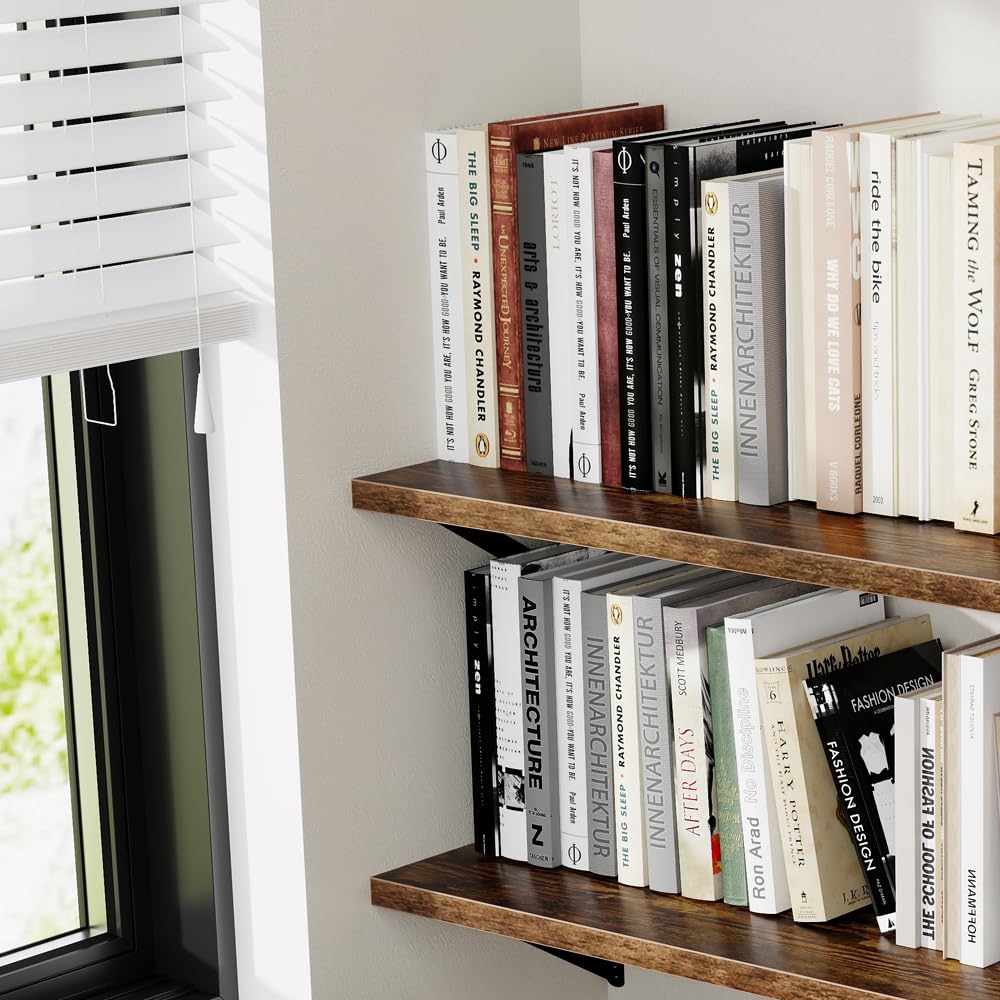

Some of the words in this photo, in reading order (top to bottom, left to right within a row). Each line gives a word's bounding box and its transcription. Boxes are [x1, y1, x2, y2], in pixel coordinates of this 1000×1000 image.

[468, 152, 476, 176] THE
[469, 183, 477, 206] BIG
[872, 172, 881, 211] ride
[471, 213, 479, 250] SLEEP
[872, 221, 881, 248] the
[499, 235, 509, 316] UNEXPECTED
[523, 242, 539, 272] arts
[624, 265, 631, 273] TO
[654, 256, 659, 268] OF
[825, 260, 838, 289] WHY
[968, 260, 979, 282] the
[827, 294, 839, 312] DO
[872, 261, 881, 303] bike
[473, 272, 482, 342] RAYMOND
[828, 317, 840, 339] WE
[500, 317, 511, 368] JOURNEY
[525, 299, 543, 392] architecture
[732, 203, 758, 457] INNENARCHITEKTUR
[828, 342, 840, 376] LOVE
[476, 349, 485, 421] CHANDLER
[828, 378, 840, 412] CATS
[969, 369, 979, 413] GREG
[853, 393, 862, 450] CORLEONE
[969, 420, 979, 470] STONE
[853, 450, 862, 495] RAQUEL
[674, 621, 685, 666] MEDBURY
[614, 637, 622, 700] CHANDLER
[679, 668, 687, 698] SCOTT
[522, 595, 543, 790] ARCHITECTURE
[769, 690, 777, 700] 6
[851, 686, 896, 713] FASHION
[896, 674, 934, 696] DESIGN
[586, 636, 610, 858] INNENARCHITEKTUR
[637, 616, 666, 848] INNENARCHITEKTUR
[679, 727, 695, 772] DAYS
[682, 781, 700, 836] AFTER
[777, 720, 794, 790] HARRY
[789, 800, 805, 867] POTTER
[827, 742, 856, 808] FASHION
[850, 814, 876, 871] DESIGN
[752, 817, 763, 858] Arad
[753, 865, 765, 899] Ron
